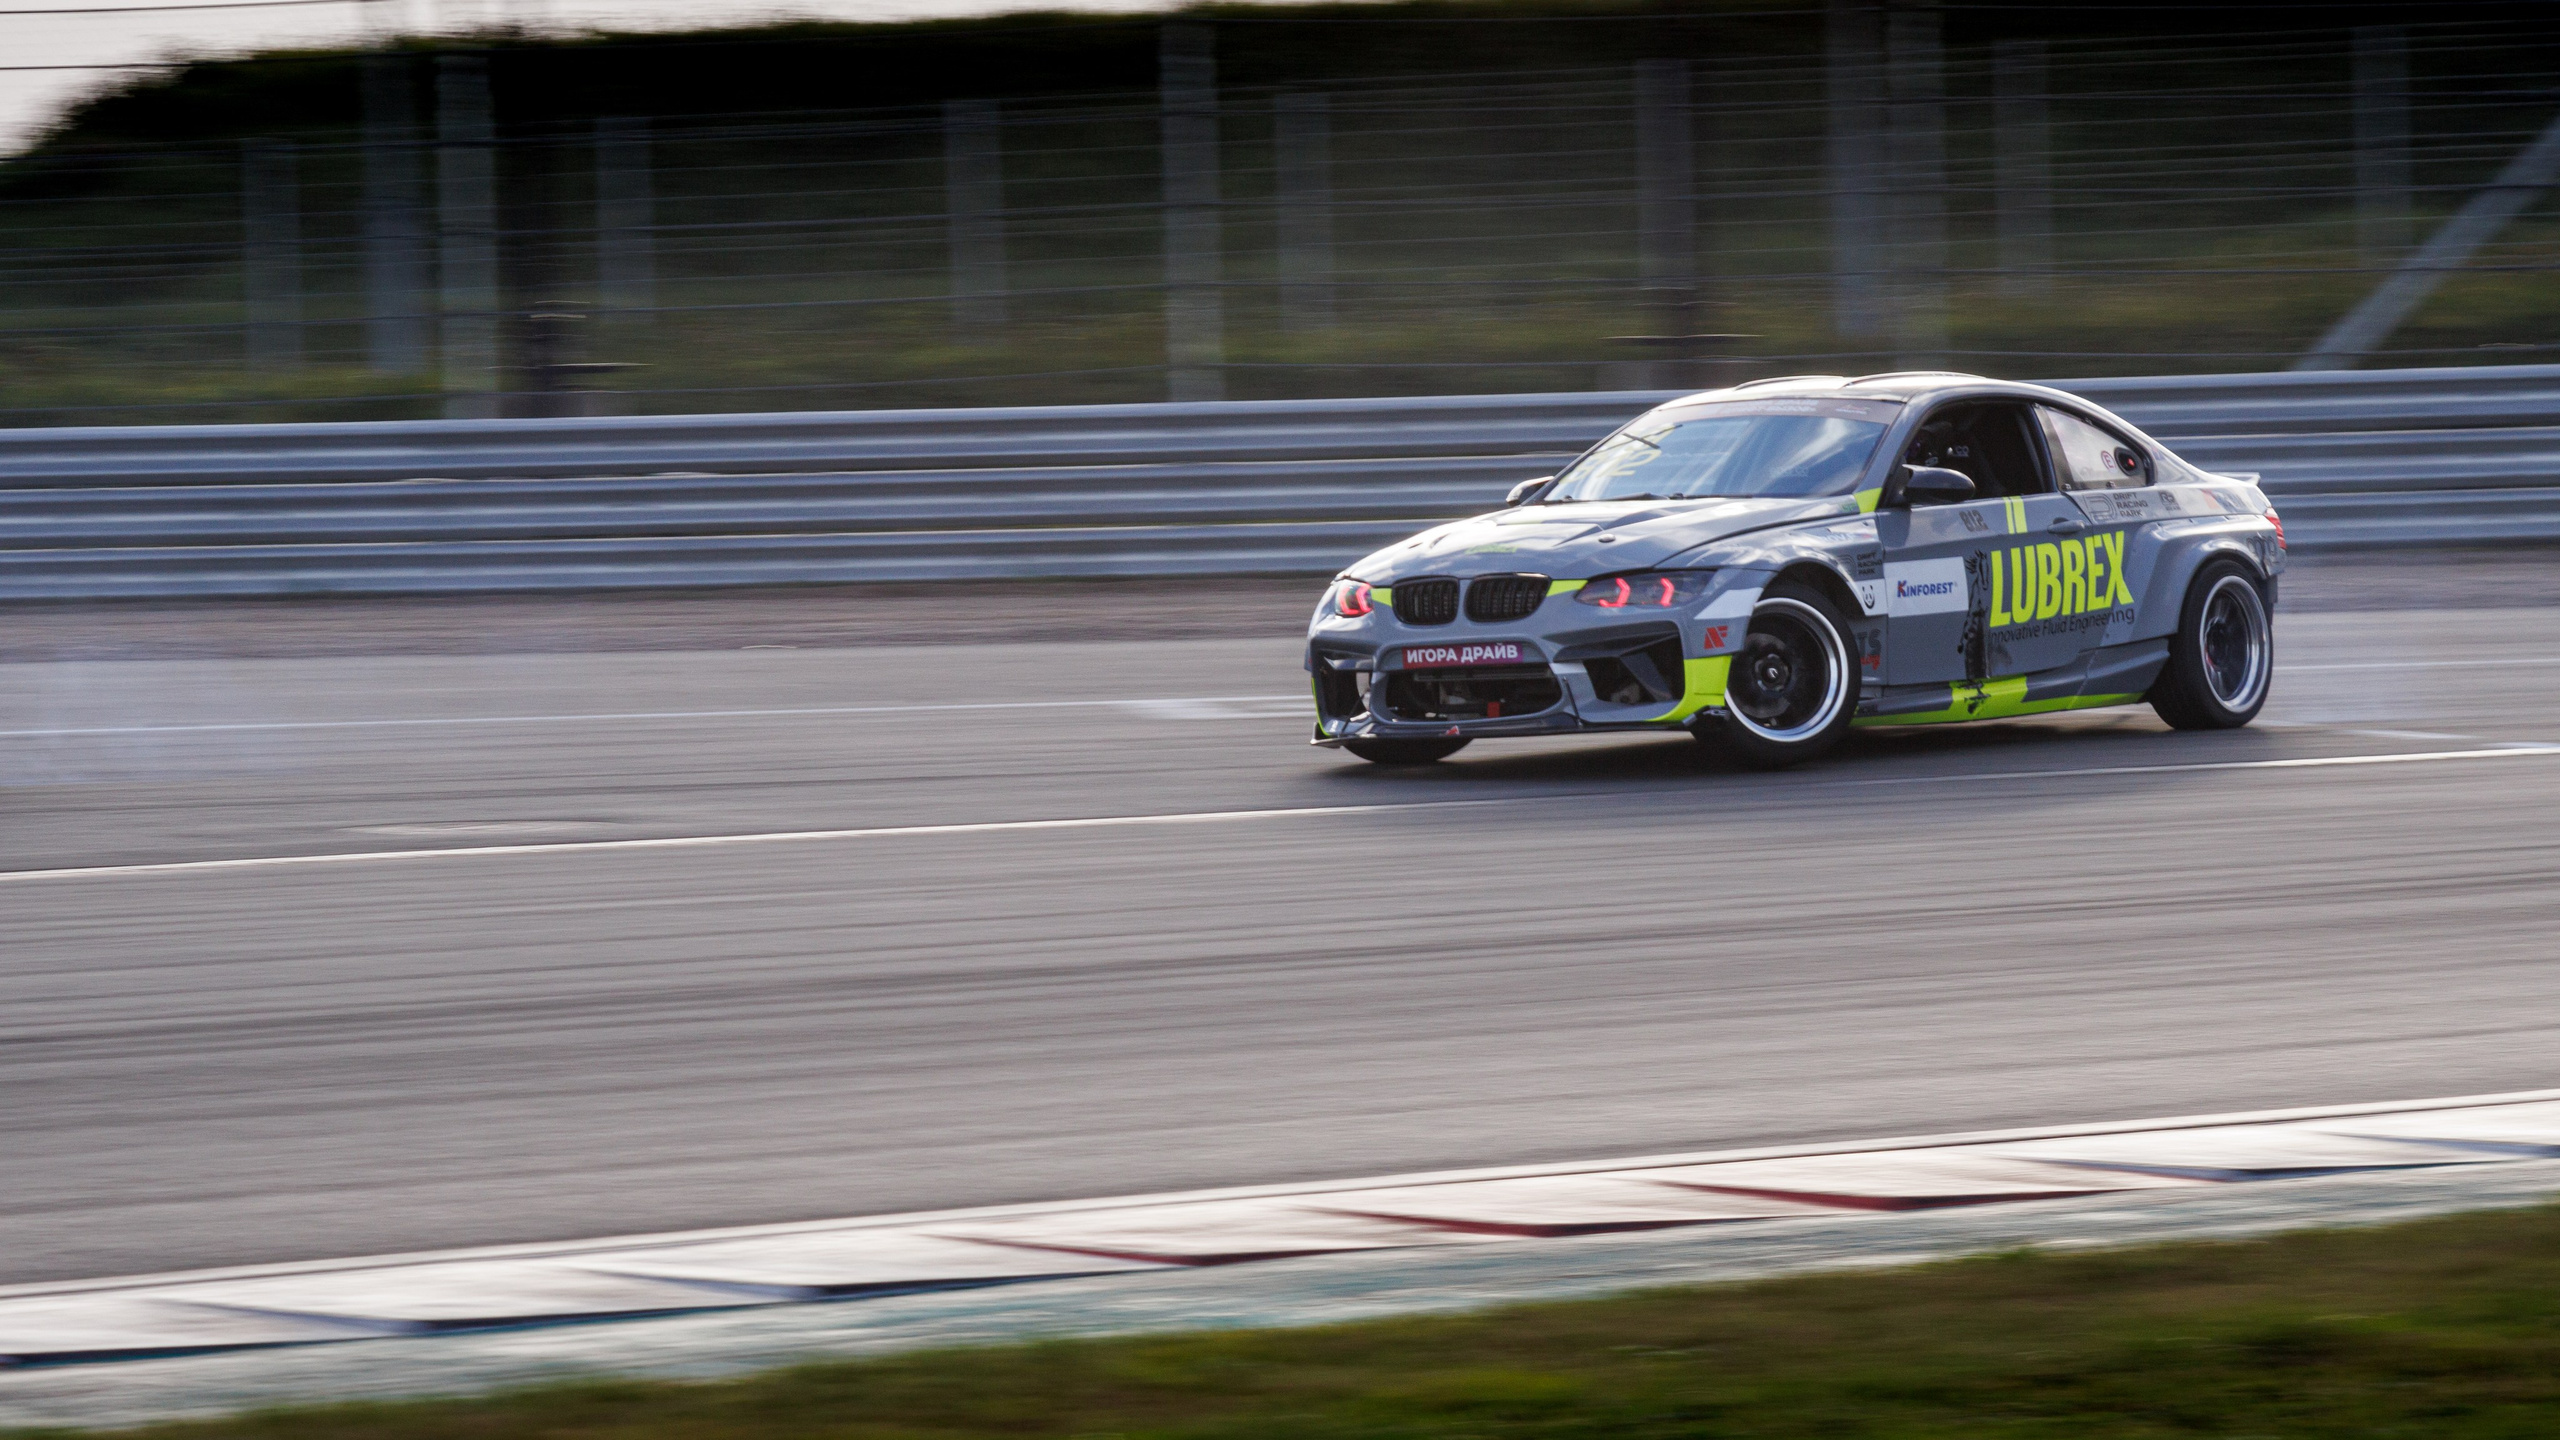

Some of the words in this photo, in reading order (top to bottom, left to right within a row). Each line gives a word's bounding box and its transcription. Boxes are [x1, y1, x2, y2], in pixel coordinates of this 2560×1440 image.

[2113, 492, 2137, 500] DRIFT
[2116, 500, 2149, 509] RACING
[1959, 509, 1989, 532] 812
[2120, 509, 2143, 518] PARK
[1857, 551, 1876, 560] DRIFT
[1990, 530, 2135, 628] LUBREX
[1988, 624, 2040, 642] Innovative
[2042, 616, 2067, 636] Fluid
[2069, 607, 2136, 634] Engineering
[1406, 647, 1458, 664] ИГОРА
[1460, 642, 1519, 664] ДРАЙВ
